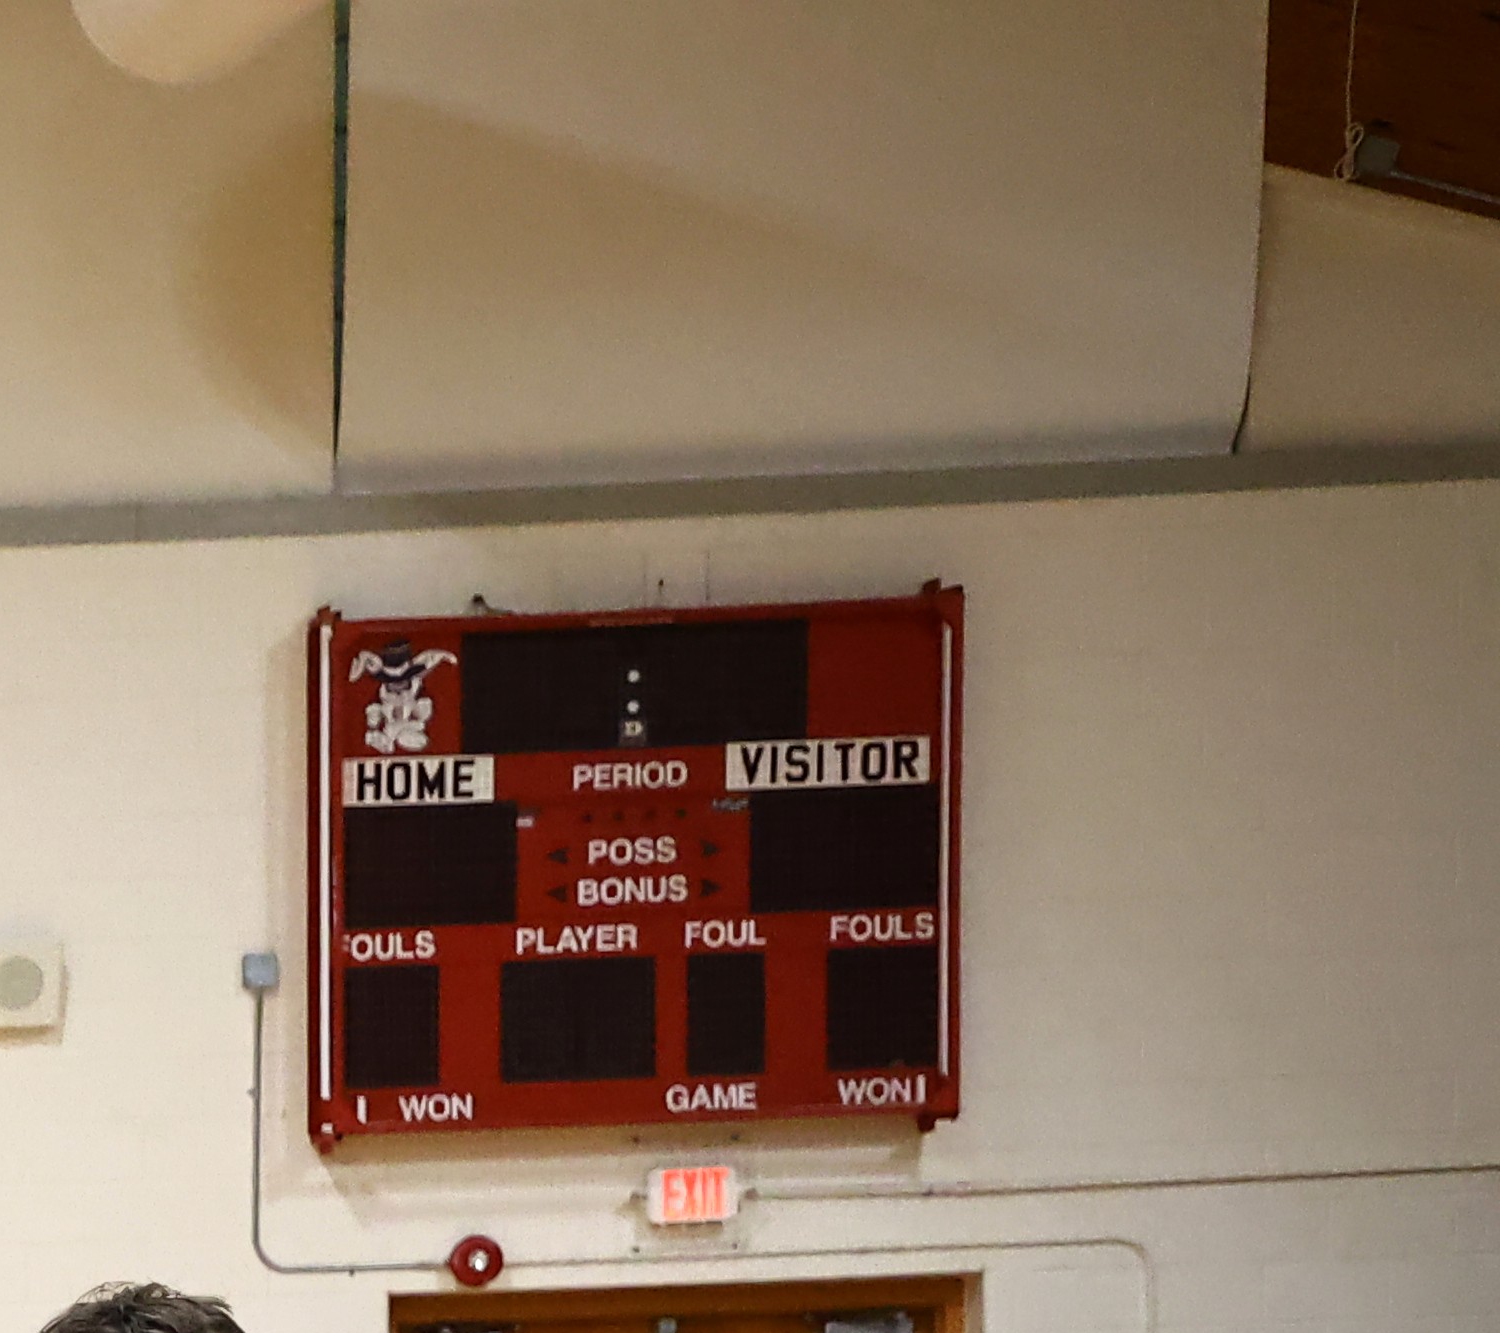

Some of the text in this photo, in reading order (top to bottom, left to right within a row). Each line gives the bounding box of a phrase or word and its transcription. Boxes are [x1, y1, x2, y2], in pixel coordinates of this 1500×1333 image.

[572, 761, 688, 790] PERIOD
[741, 741, 920, 786] VISITOR
[355, 760, 475, 801] HOME
[588, 836, 676, 867] POSS
[577, 875, 688, 907] BONUS
[516, 919, 766, 954] PLAYER FOUL
[829, 914, 934, 942] FOULS
[666, 1083, 757, 1111] GAME
[838, 1077, 910, 1105] WON
[399, 1093, 474, 1121] WON
[663, 1167, 729, 1220] EXIT
